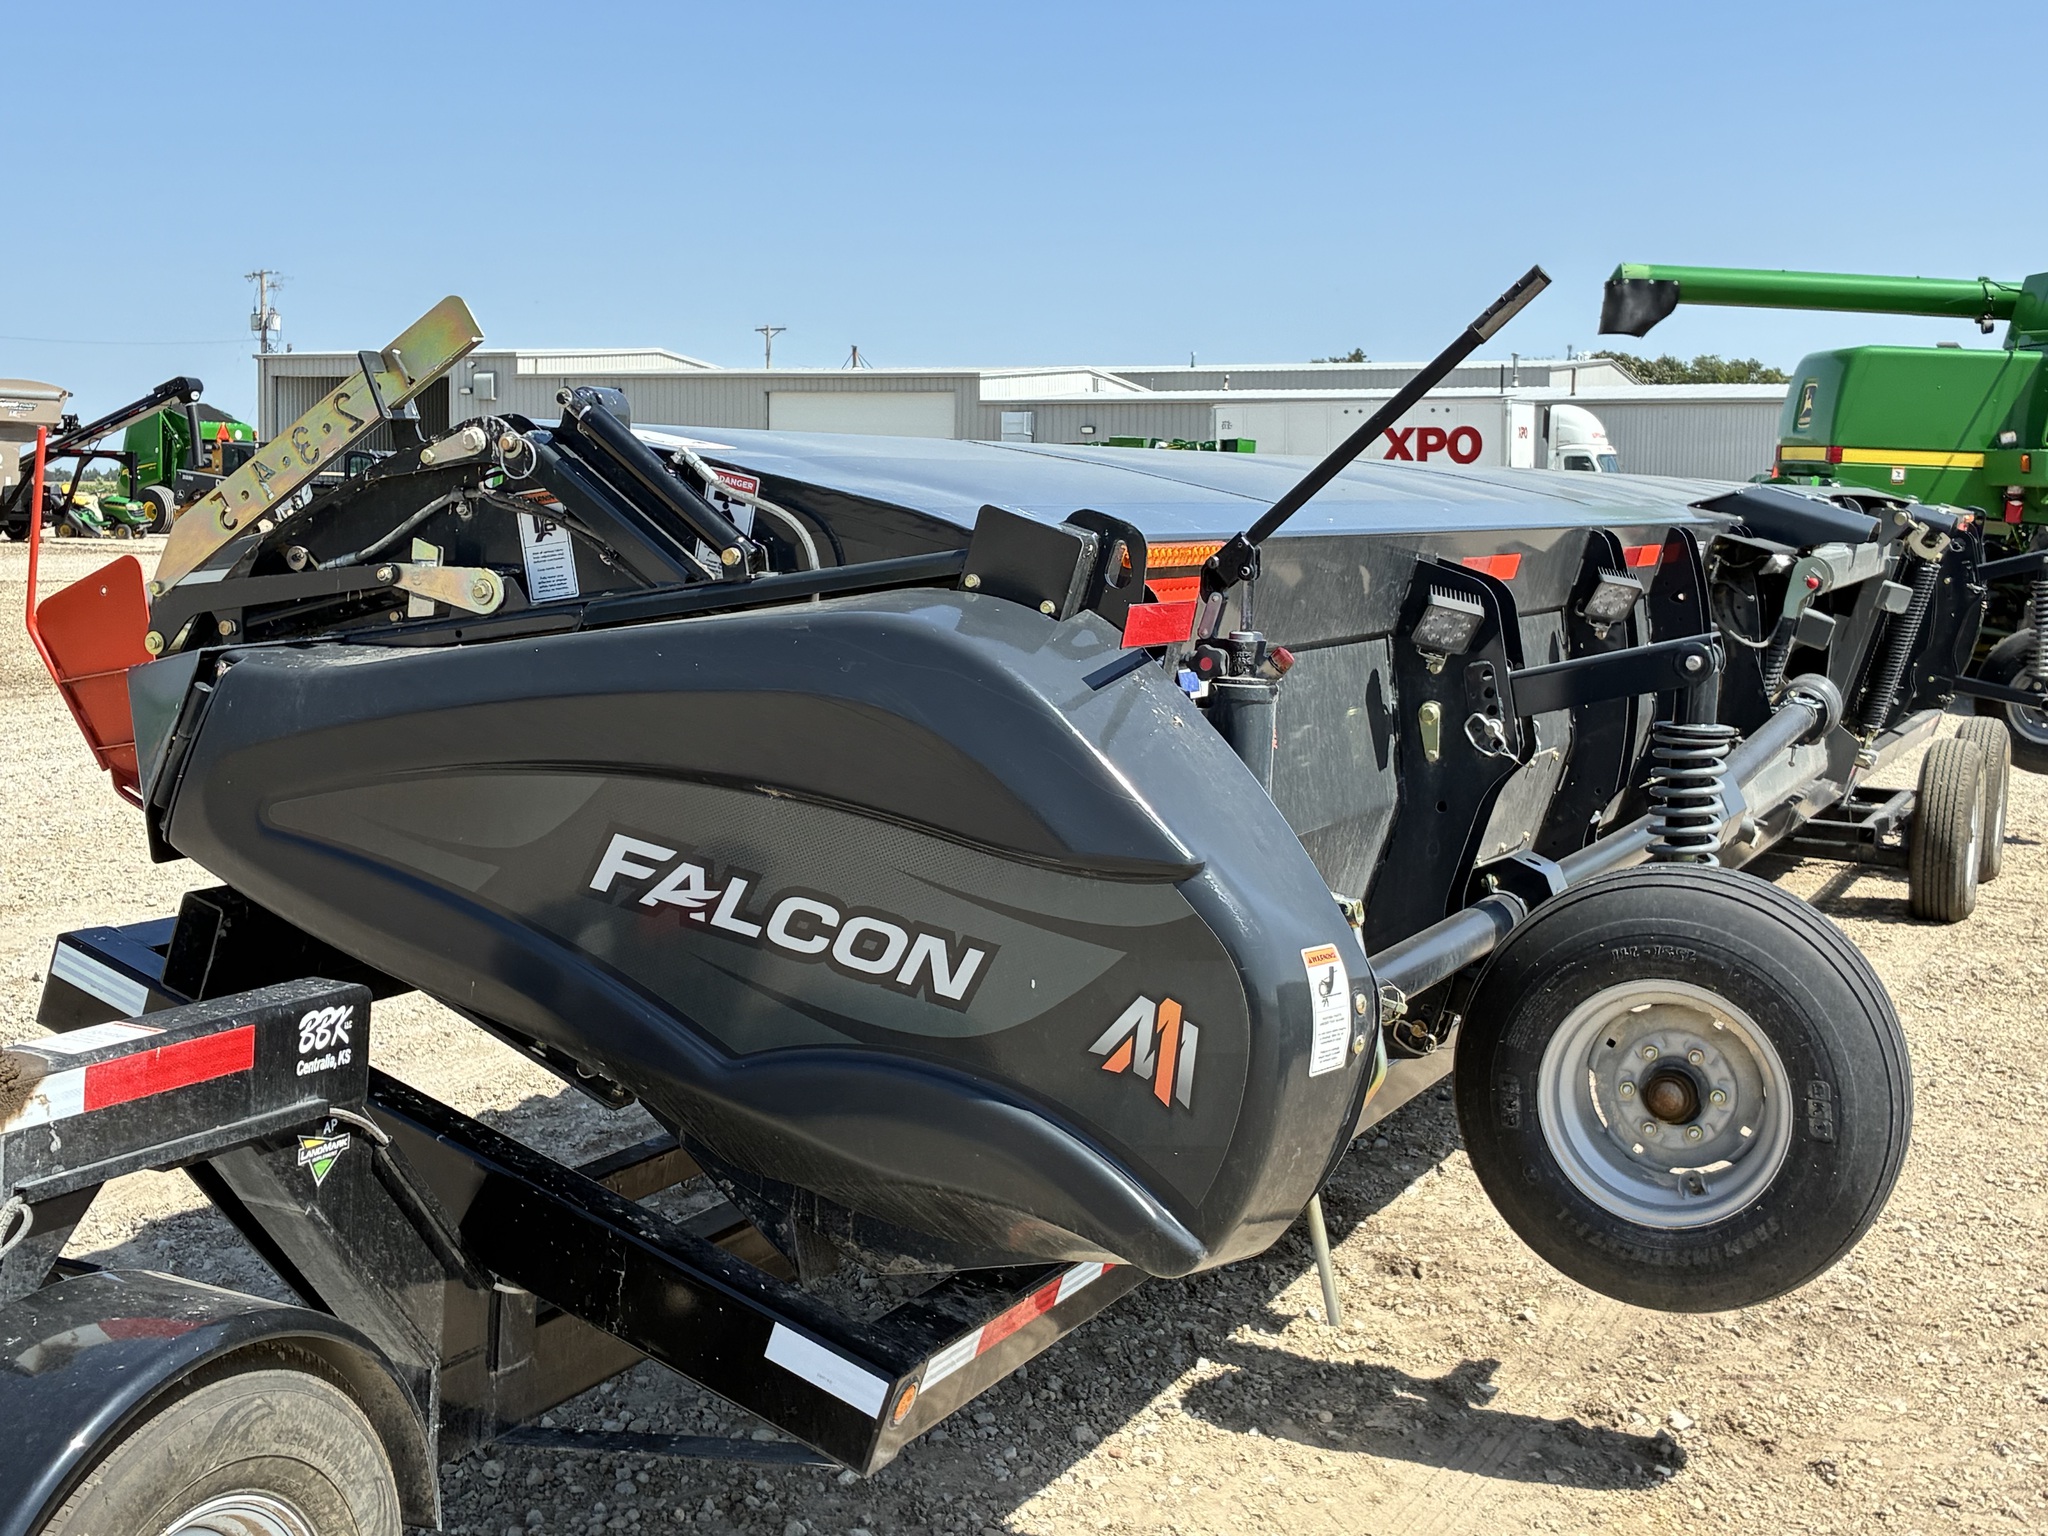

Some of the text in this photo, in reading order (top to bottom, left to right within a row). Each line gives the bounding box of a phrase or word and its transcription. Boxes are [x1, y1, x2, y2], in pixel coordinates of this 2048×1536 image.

[1383, 426, 1482, 464] XPO
[719, 475, 754, 490] DANGER
[589, 833, 985, 1000] FALCON
[299, 1005, 354, 1054] BBK
[296, 1048, 351, 1076] Centralia, KS
[323, 1118, 338, 1135] AP
